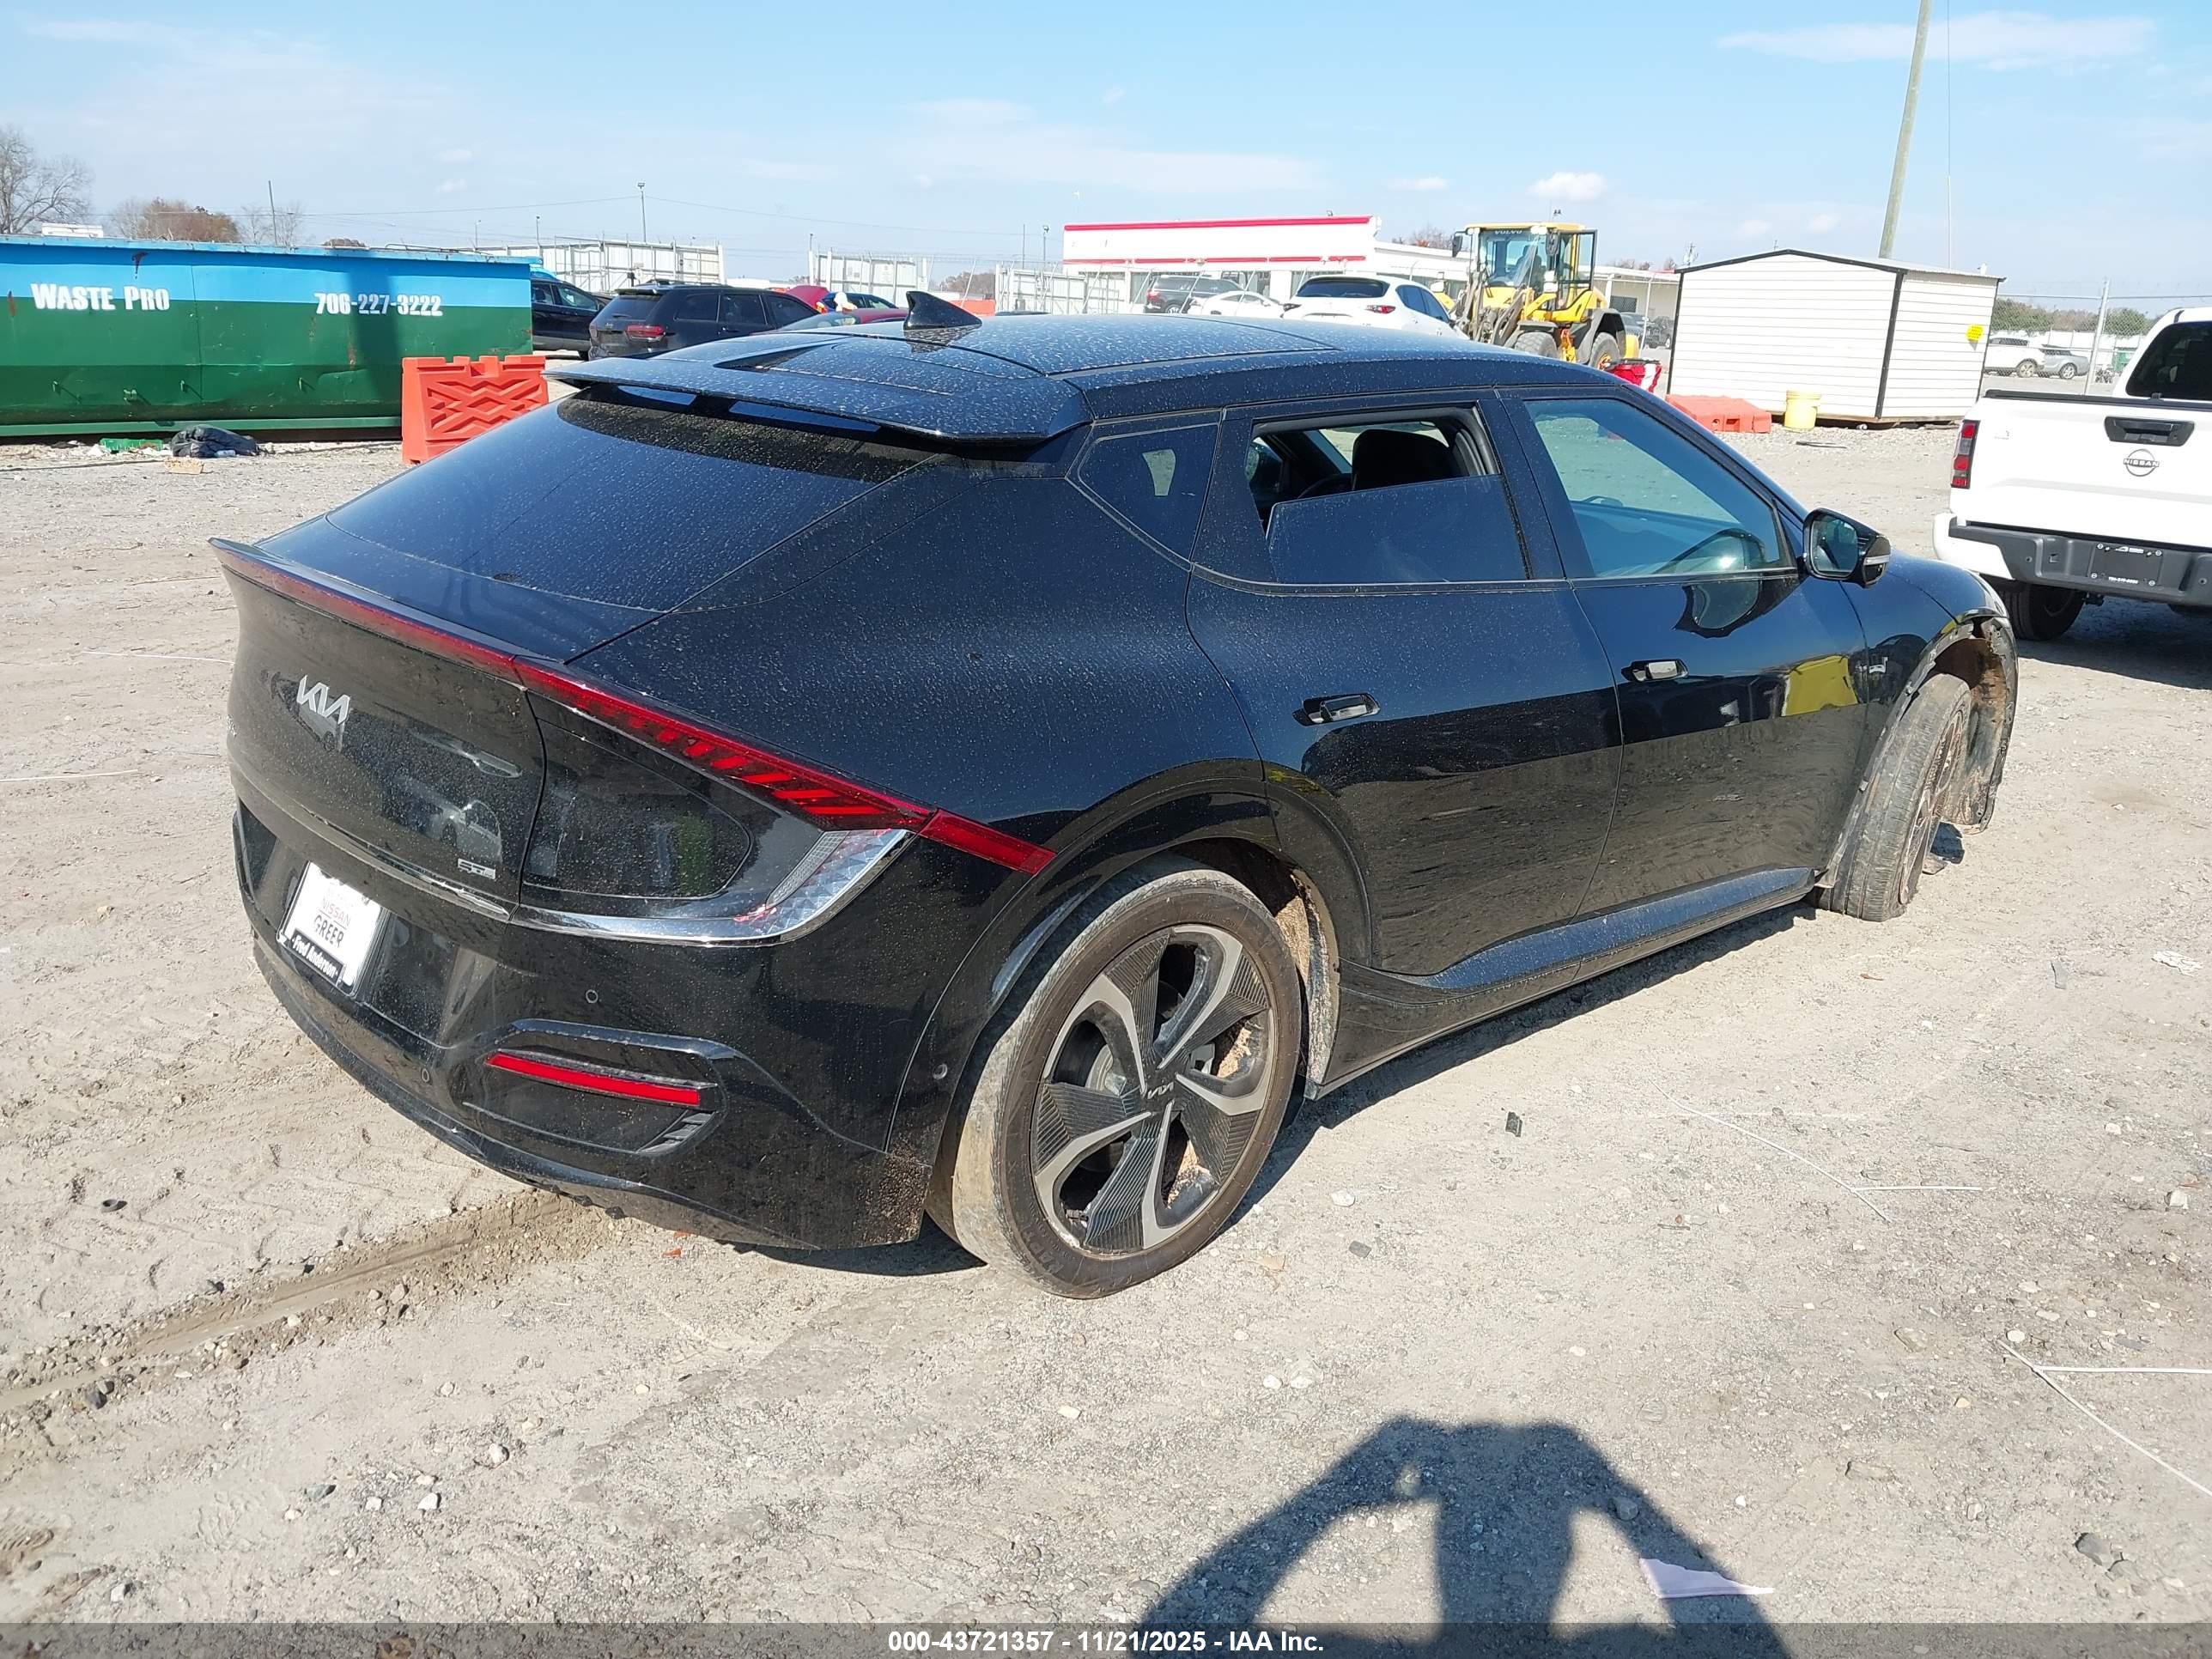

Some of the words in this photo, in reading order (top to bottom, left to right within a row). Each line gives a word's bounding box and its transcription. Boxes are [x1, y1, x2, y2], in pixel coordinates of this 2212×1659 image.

[30, 283, 116, 311] WASTE
[124, 285, 170, 311] PRO
[314, 293, 443, 317] 706-227-3222
[2123, 458, 2160, 468] NISSAN
[296, 674, 350, 725] KIA
[313, 914, 344, 948] GREER
[292, 933, 310, 957] Fred
[306, 945, 337, 979] Anderson
